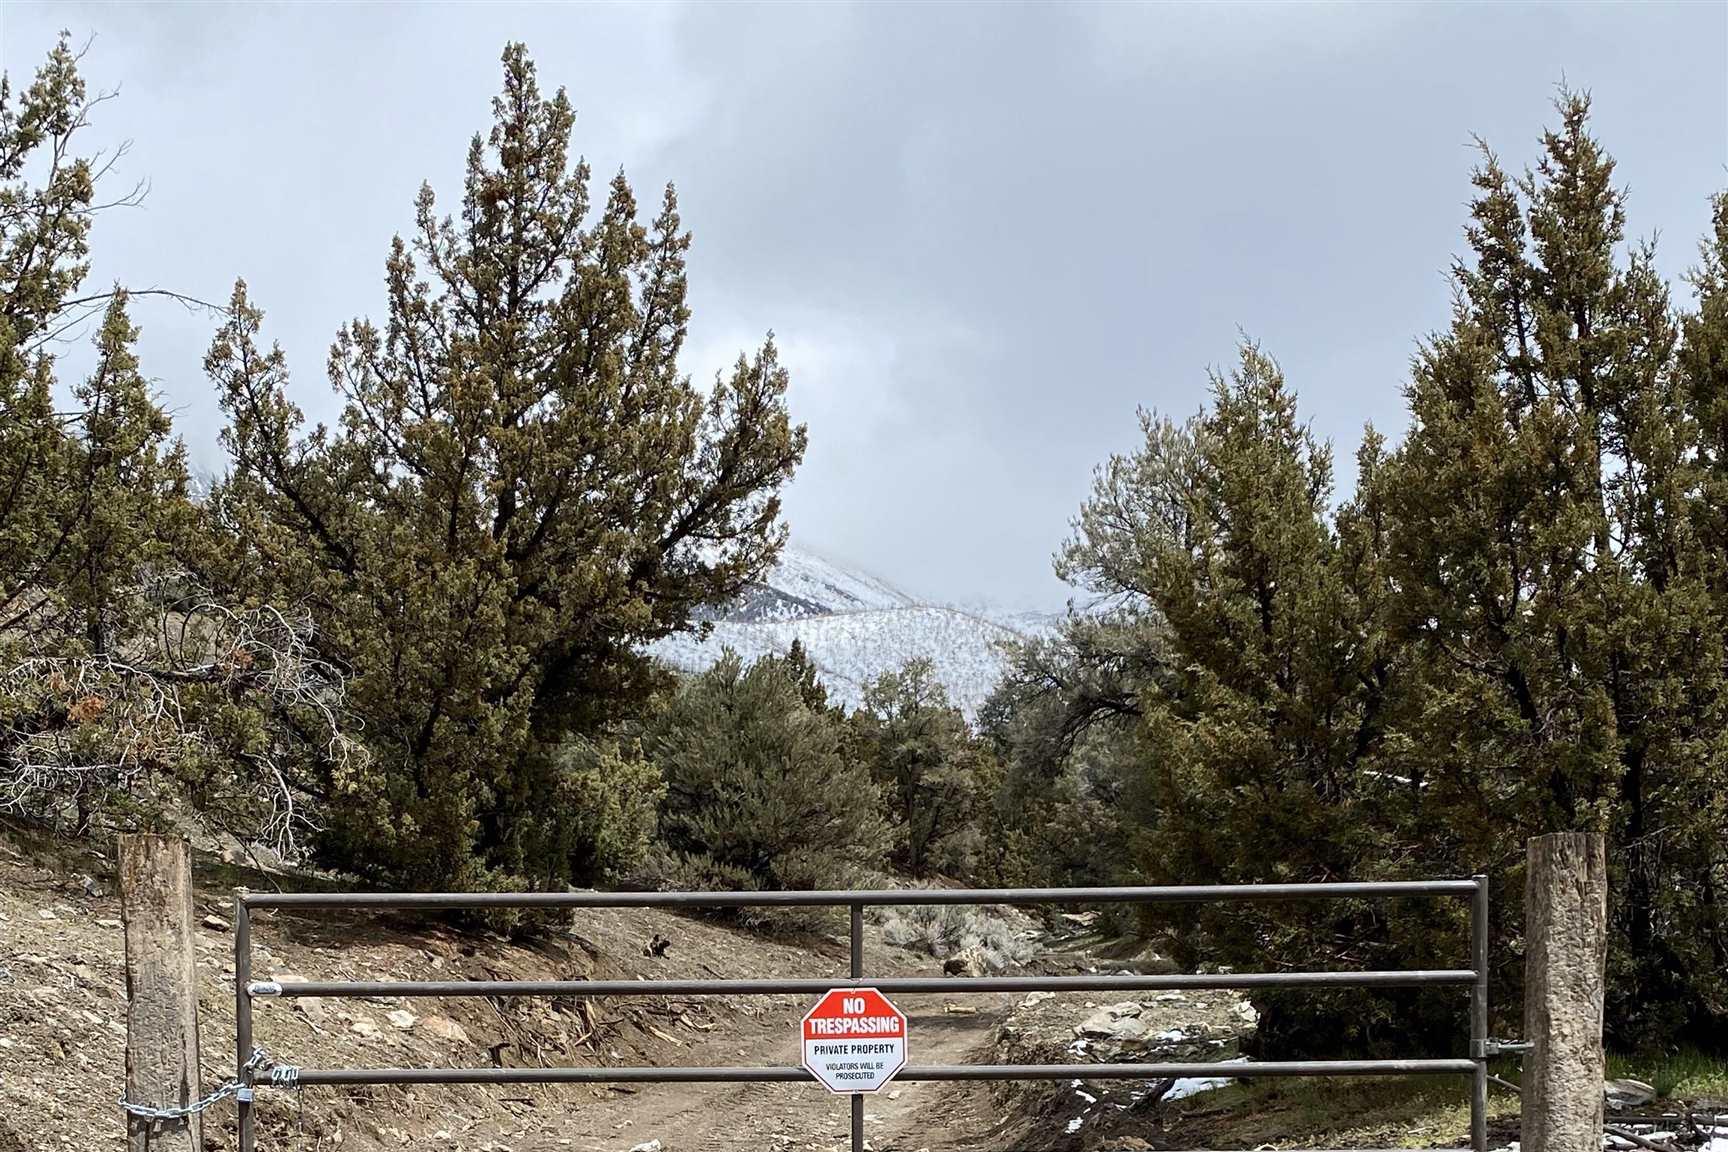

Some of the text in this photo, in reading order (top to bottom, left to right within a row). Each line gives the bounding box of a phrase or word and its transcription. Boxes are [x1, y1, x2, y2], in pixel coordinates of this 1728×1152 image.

[843, 997, 866, 1014] NO
[808, 1016, 900, 1034] TRESPASSING
[814, 1044, 895, 1055] PRIVATE PROPERTY
[826, 1062, 859, 1071] VIOLATORS
[860, 1062, 875, 1070] WILL
[835, 1072, 875, 1080] PROSECUTED
